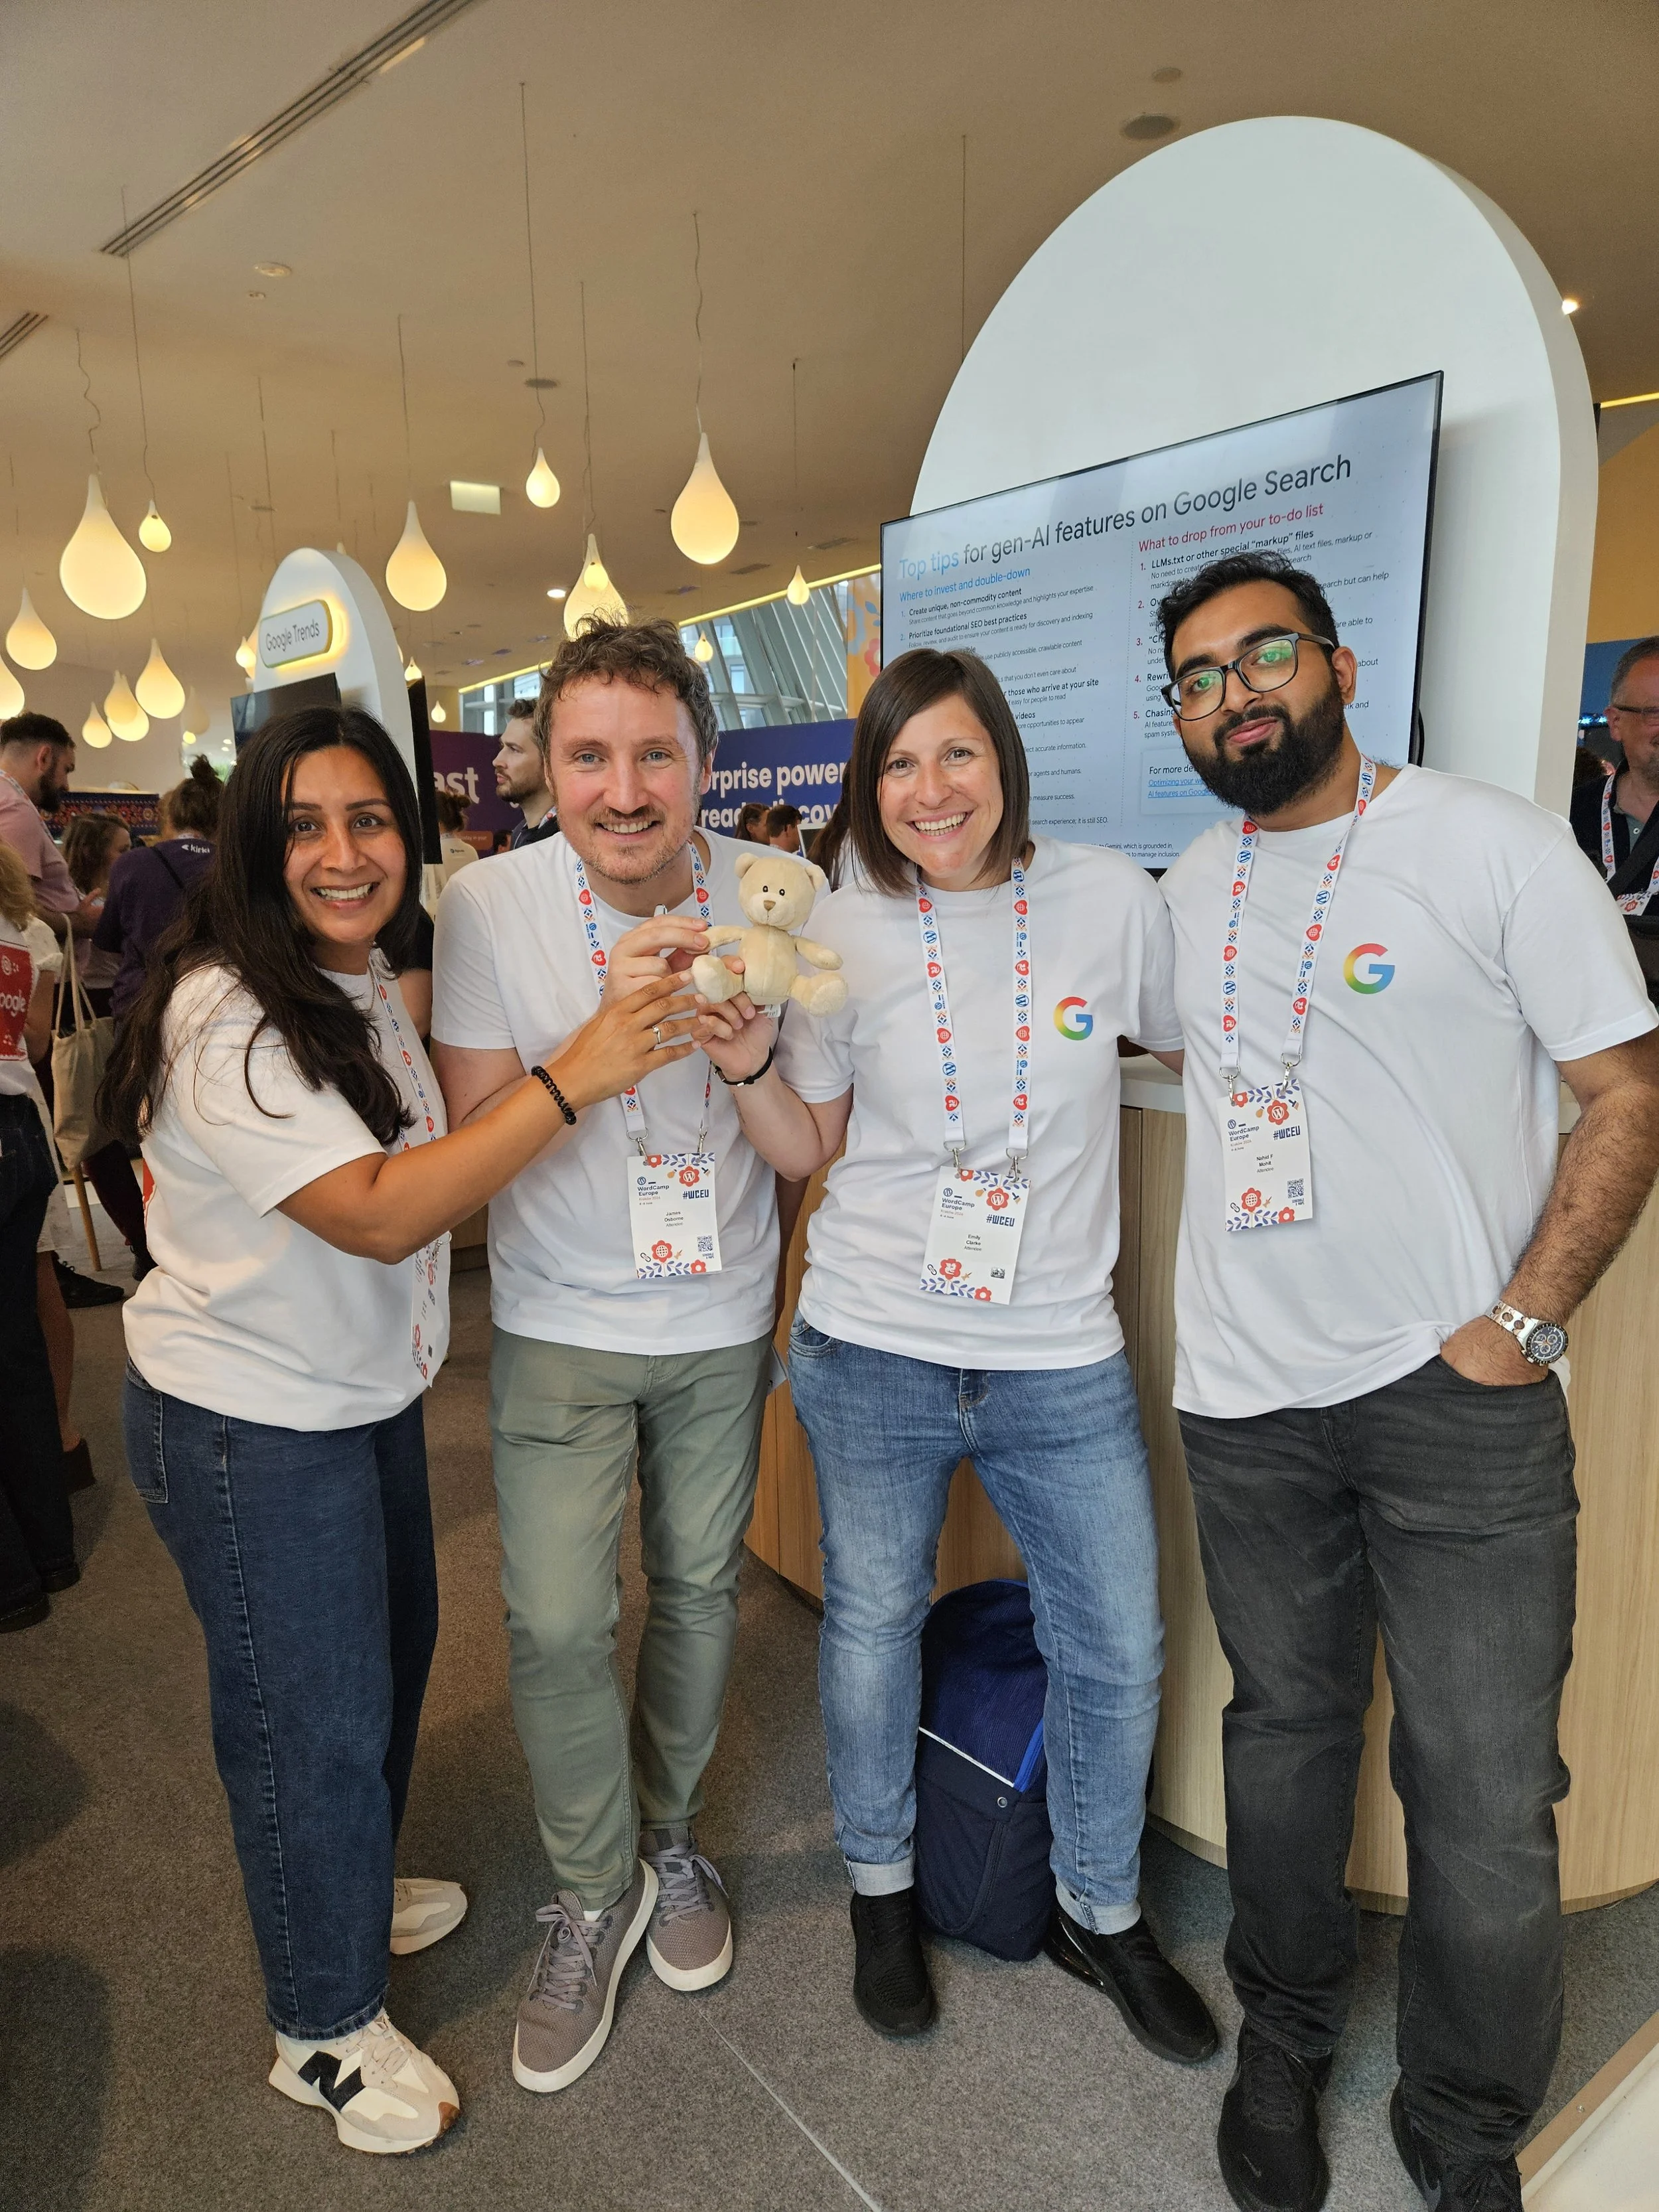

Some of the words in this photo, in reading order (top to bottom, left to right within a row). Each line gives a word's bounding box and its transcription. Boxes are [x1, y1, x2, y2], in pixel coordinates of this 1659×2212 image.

[899, 557, 926, 581] Top
[930, 551, 959, 575] tips
[964, 544, 987, 564] for
[991, 524, 1050, 563] gen-AI
[1056, 509, 1135, 544] features
[1141, 502, 1167, 524] on
[1174, 479, 1257, 512] Google
[1265, 454, 1351, 495] Search
[1139, 537, 1165, 552] What
[1169, 536, 1179, 546] to
[1181, 531, 1206, 542] drop
[1210, 524, 1236, 537] from
[1240, 517, 1265, 534] your
[1269, 509, 1303, 525] to-do
[1306, 503, 1323, 517] list
[1151, 555, 1184, 569] LLMs.txt
[1196, 549, 1218, 559] other
[1220, 542, 1250, 555] special
[1295, 530, 1314, 540] files
[1161, 568, 1175, 577] need
[1335, 534, 1362, 545] markup
[900, 591, 923, 602] Where
[934, 583, 957, 595] invest
[959, 578, 973, 590] and
[975, 568, 1030, 587] double-down
[1344, 575, 1356, 585] but
[1373, 571, 1389, 581] help
[909, 607, 927, 615] Create
[928, 603, 948, 613] unique,
[950, 593, 996, 608] non-commodity
[997, 587, 1022, 599] content
[921, 615, 937, 623] content
[958, 608, 975, 618] beyond
[997, 600, 1022, 609] knowledge
[1033, 592, 1056, 602] highlights
[1070, 585, 1094, 595] expertise
[265, 628, 292, 652] Google
[293, 619, 320, 642] Trends
[909, 628, 932, 639] Prioritize
[934, 623, 970, 635] foundational
[971, 620, 982, 628] SEO
[999, 613, 1027, 626] practices
[1348, 618, 1364, 627] able
[1008, 688, 1025, 696] those
[1042, 682, 1060, 692] arrive
[1070, 681, 1085, 691] your
[1147, 671, 1168, 681] Rewri
[1031, 697, 1047, 705] people
[1027, 719, 1059, 729] opportunities
[711, 762, 772, 798] rprise
[1342, 942, 1396, 994] G
[0, 990, 27, 1017] oogle
[1052, 996, 1093, 1041] G
[1228, 1126, 1260, 1136] WordCamp
[1273, 1126, 1301, 1140] #WCEU
[683, 1189, 709, 1200] #WCEU
[942, 1197, 975, 1208] WordCamp
[986, 1215, 1015, 1227] #WCEU
